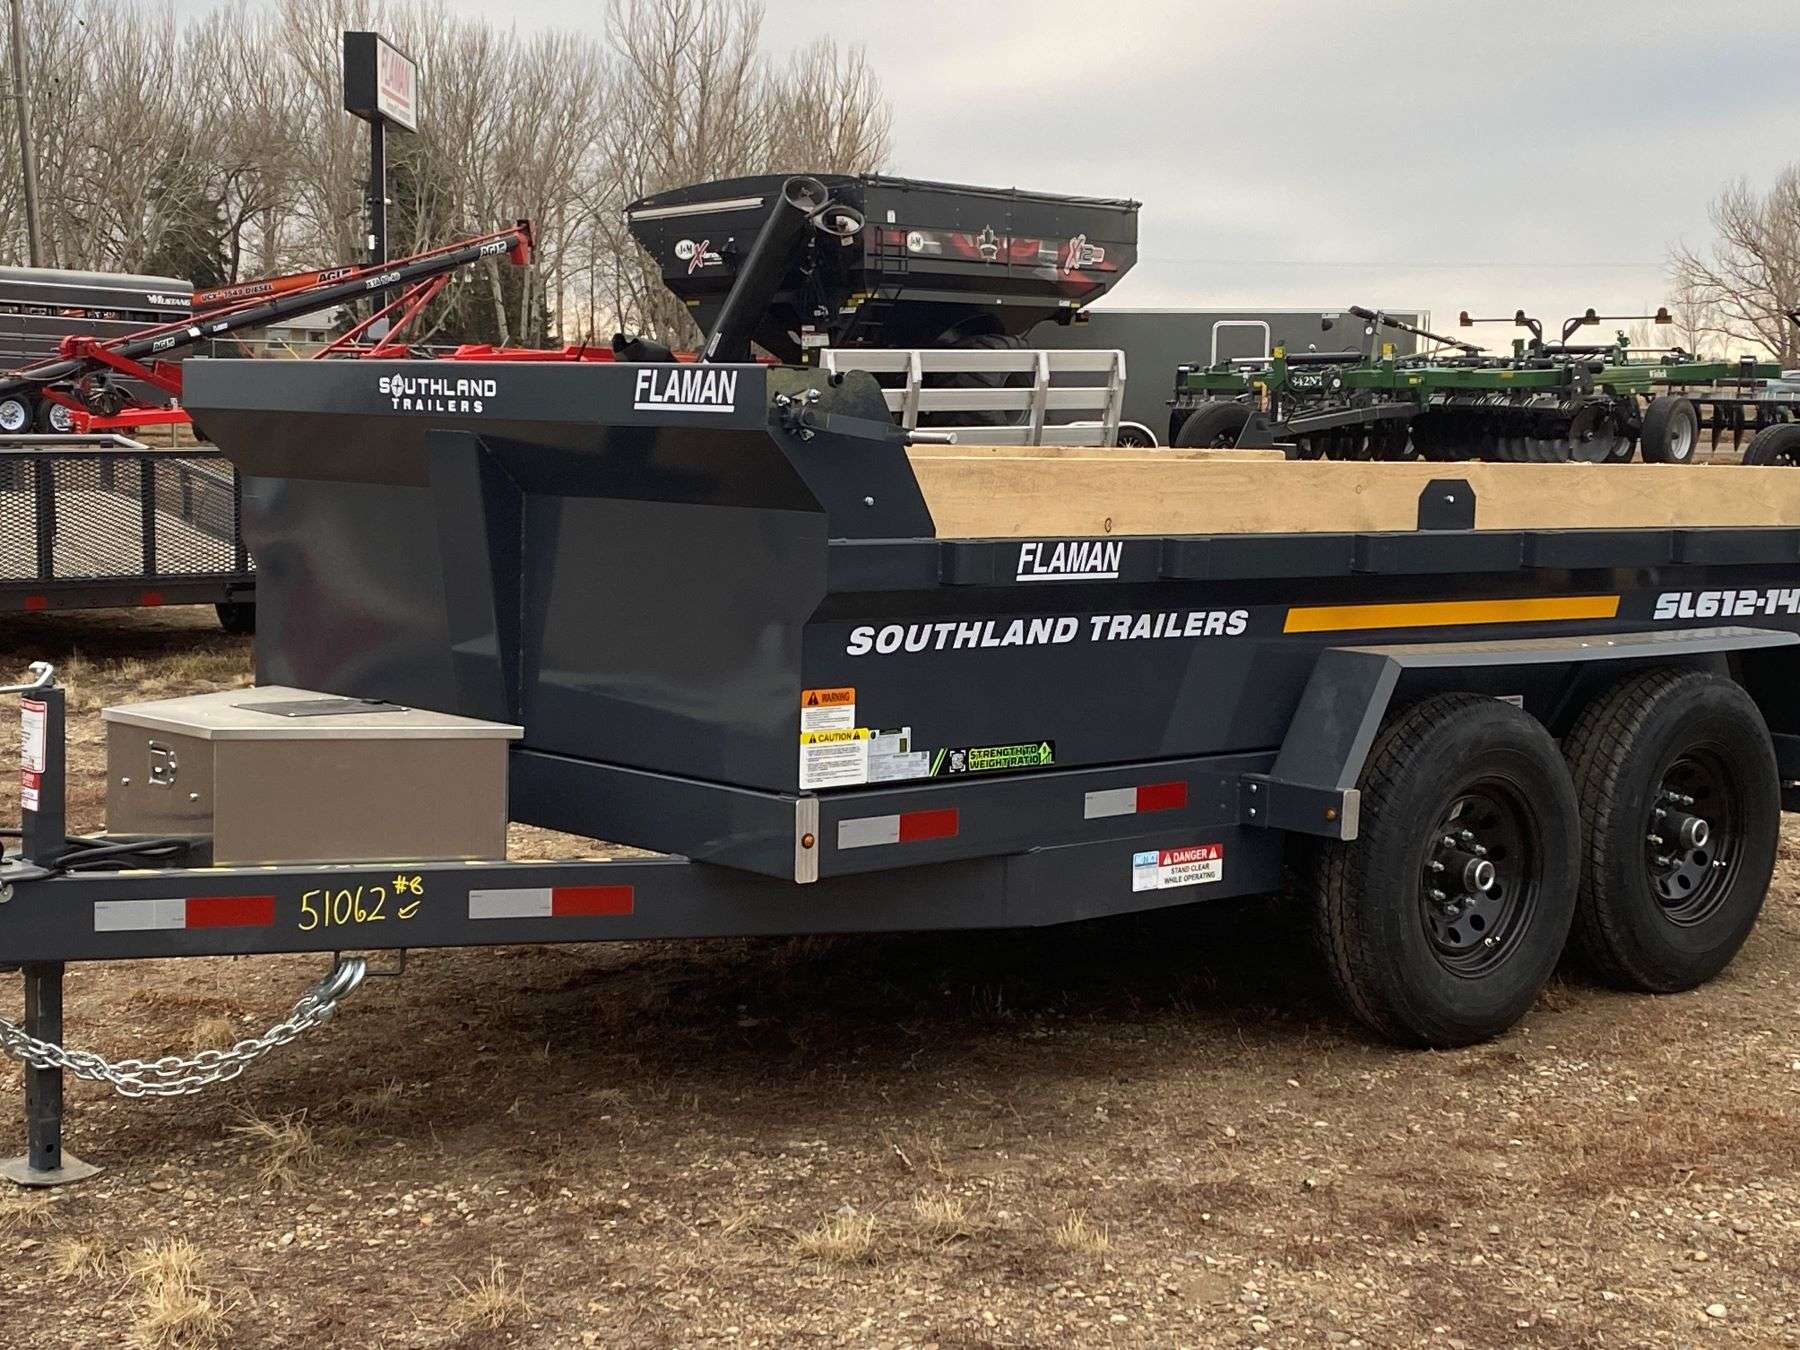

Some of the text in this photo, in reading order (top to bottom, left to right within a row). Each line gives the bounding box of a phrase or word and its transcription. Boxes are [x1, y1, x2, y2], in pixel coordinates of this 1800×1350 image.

[245, 284, 273, 295] DIESEL
[379, 373, 497, 398] SOUTHLAND
[634, 369, 738, 404] FLAMAN
[391, 398, 484, 413] TRAILERS
[1016, 541, 1123, 574] FLAMAN
[1653, 588, 1800, 620] SL612-14
[846, 609, 1249, 656] SOUTHLAND TRAILERS
[821, 691, 850, 702] WARNING
[818, 732, 852, 743] CAUTION
[969, 744, 1038, 760] STRENGTH TO
[969, 754, 1039, 769] WEIGHT RATIO
[1173, 848, 1208, 863] DANGER
[1171, 863, 1210, 874] STAND CLEAR
[1164, 875, 1182, 884] WHILE
[1183, 871, 1216, 882] OPERATING
[298, 886, 386, 931] 51062
